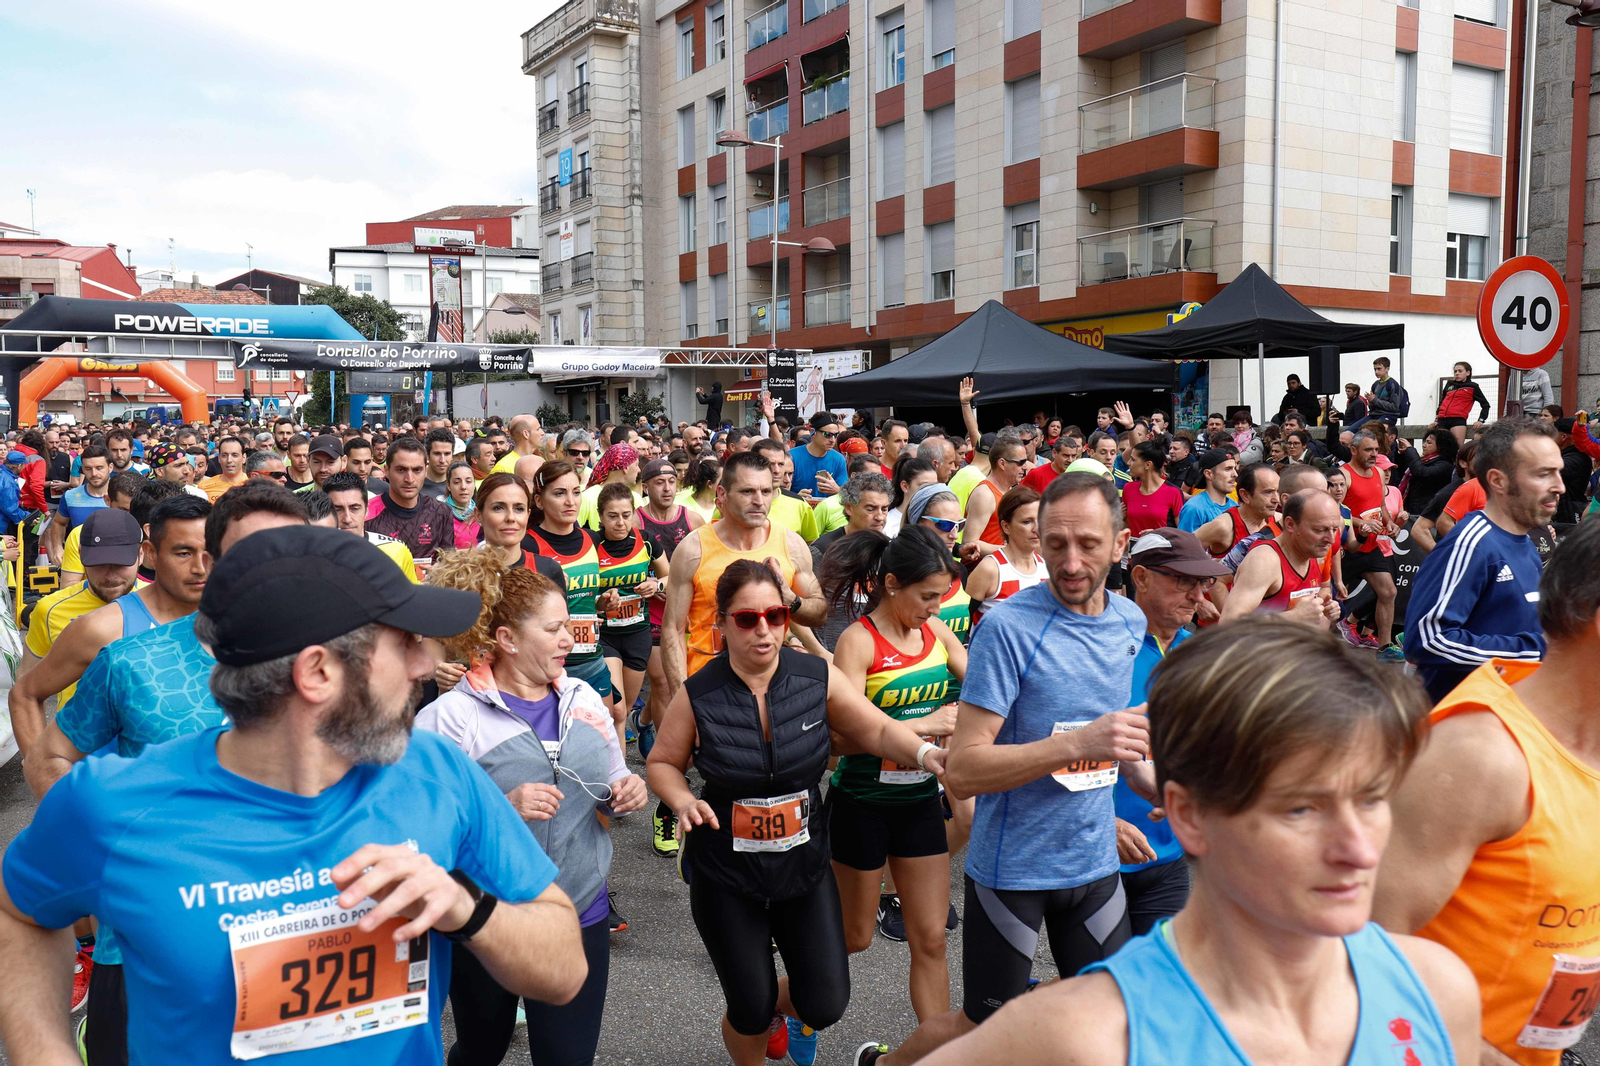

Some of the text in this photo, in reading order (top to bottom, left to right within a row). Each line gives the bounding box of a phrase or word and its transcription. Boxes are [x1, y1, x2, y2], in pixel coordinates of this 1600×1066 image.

[114, 313, 270, 334] POWERADE
[1501, 295, 1553, 332] 40
[317, 344, 458, 360] Concello do Porriño
[350, 360, 384, 369] Concello
[385, 361, 398, 369] do
[399, 361, 431, 370] Deporte
[494, 361, 524, 370] Porriño
[562, 362, 655, 372] Grupo Godoy Maceira
[402, 376, 411, 390] 0
[744, 392, 753, 400] 32
[617, 604, 634, 619] 310
[751, 813, 786, 839] 319
[179, 884, 205, 909] VI
[211, 867, 315, 906] Travesía
[218, 910, 279, 932] Costa
[240, 930, 260, 944] XIII
[264, 916, 319, 937] CARREIRA
[322, 914, 336, 927] DE
[340, 912, 348, 923] O
[308, 931, 352, 951] PABLO
[279, 944, 376, 1020] 329
